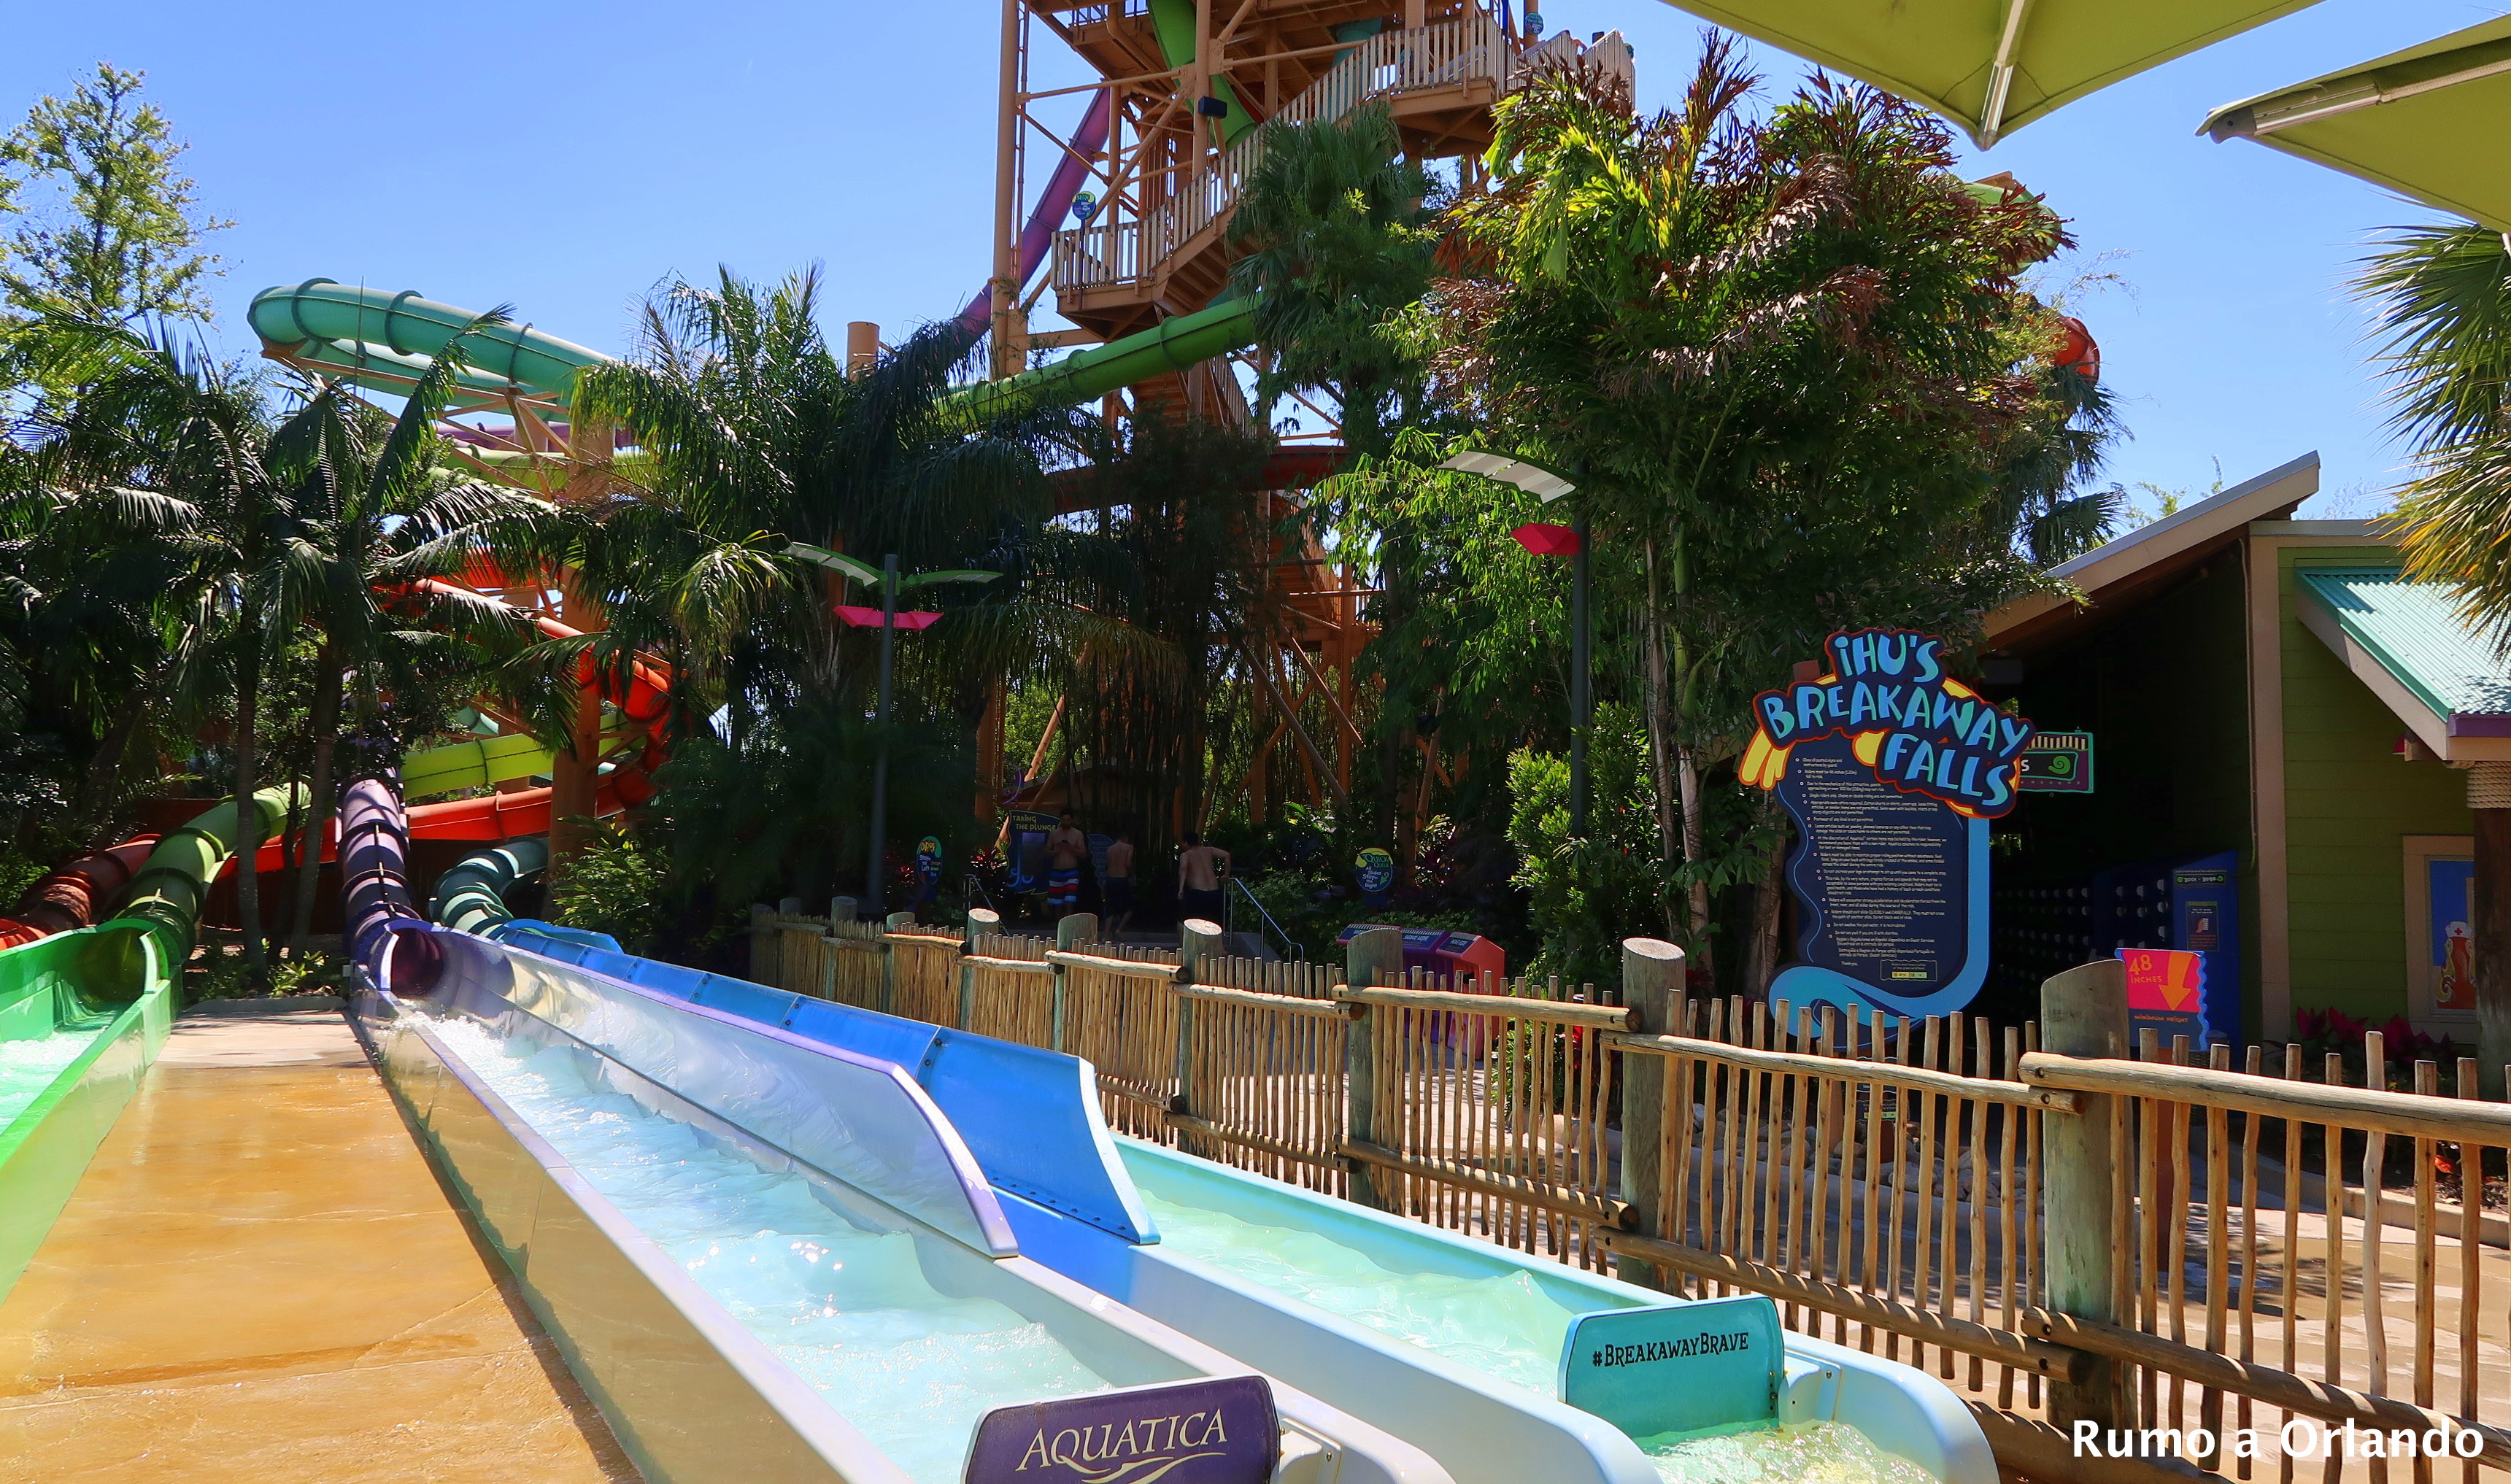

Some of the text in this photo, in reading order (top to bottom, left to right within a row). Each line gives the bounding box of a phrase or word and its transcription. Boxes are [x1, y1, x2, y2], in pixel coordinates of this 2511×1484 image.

[1764, 681, 2029, 757] BREAKAWAY
[1883, 733, 2010, 806] FALLS
[2129, 954, 2153, 975] 48
[1015, 1408, 1227, 1472] AQUATICA
